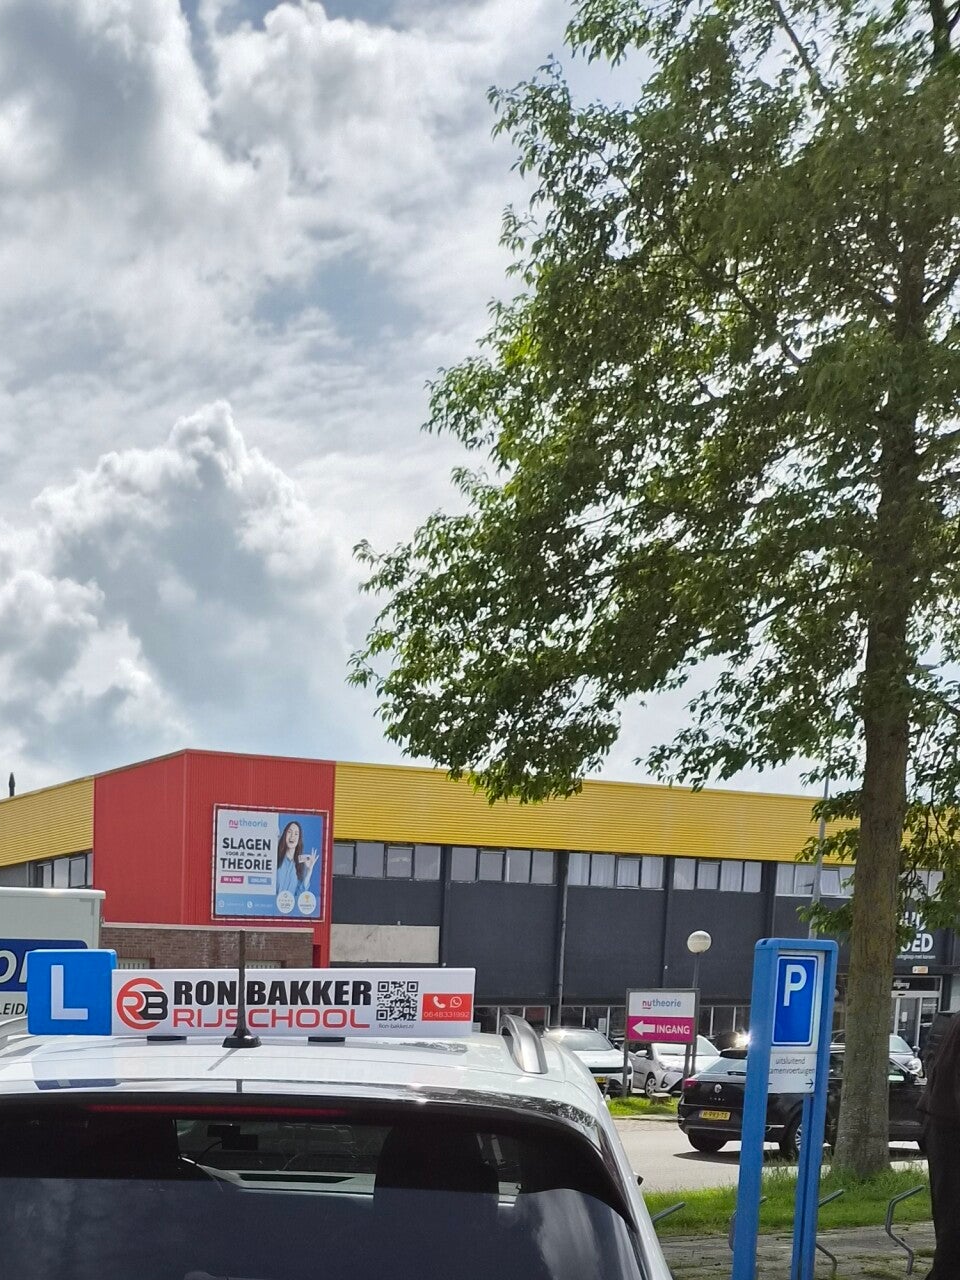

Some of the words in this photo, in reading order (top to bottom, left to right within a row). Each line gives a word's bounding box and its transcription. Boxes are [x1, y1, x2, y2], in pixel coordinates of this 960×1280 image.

[222, 837, 272, 851] SLAGEN
[220, 858, 273, 871] THEORIE
[782, 963, 808, 1007] P
[50, 964, 89, 1021] L
[173, 980, 237, 1006] RON
[246, 980, 373, 1006] BAKKER
[641, 998, 682, 1009] nutheorie
[171, 1008, 371, 1029] RIJSCHOOL
[656, 1024, 691, 1035] INGANG
[775, 1056, 806, 1065] uitsluitend
[769, 1067, 815, 1076] amenvoertuigen
